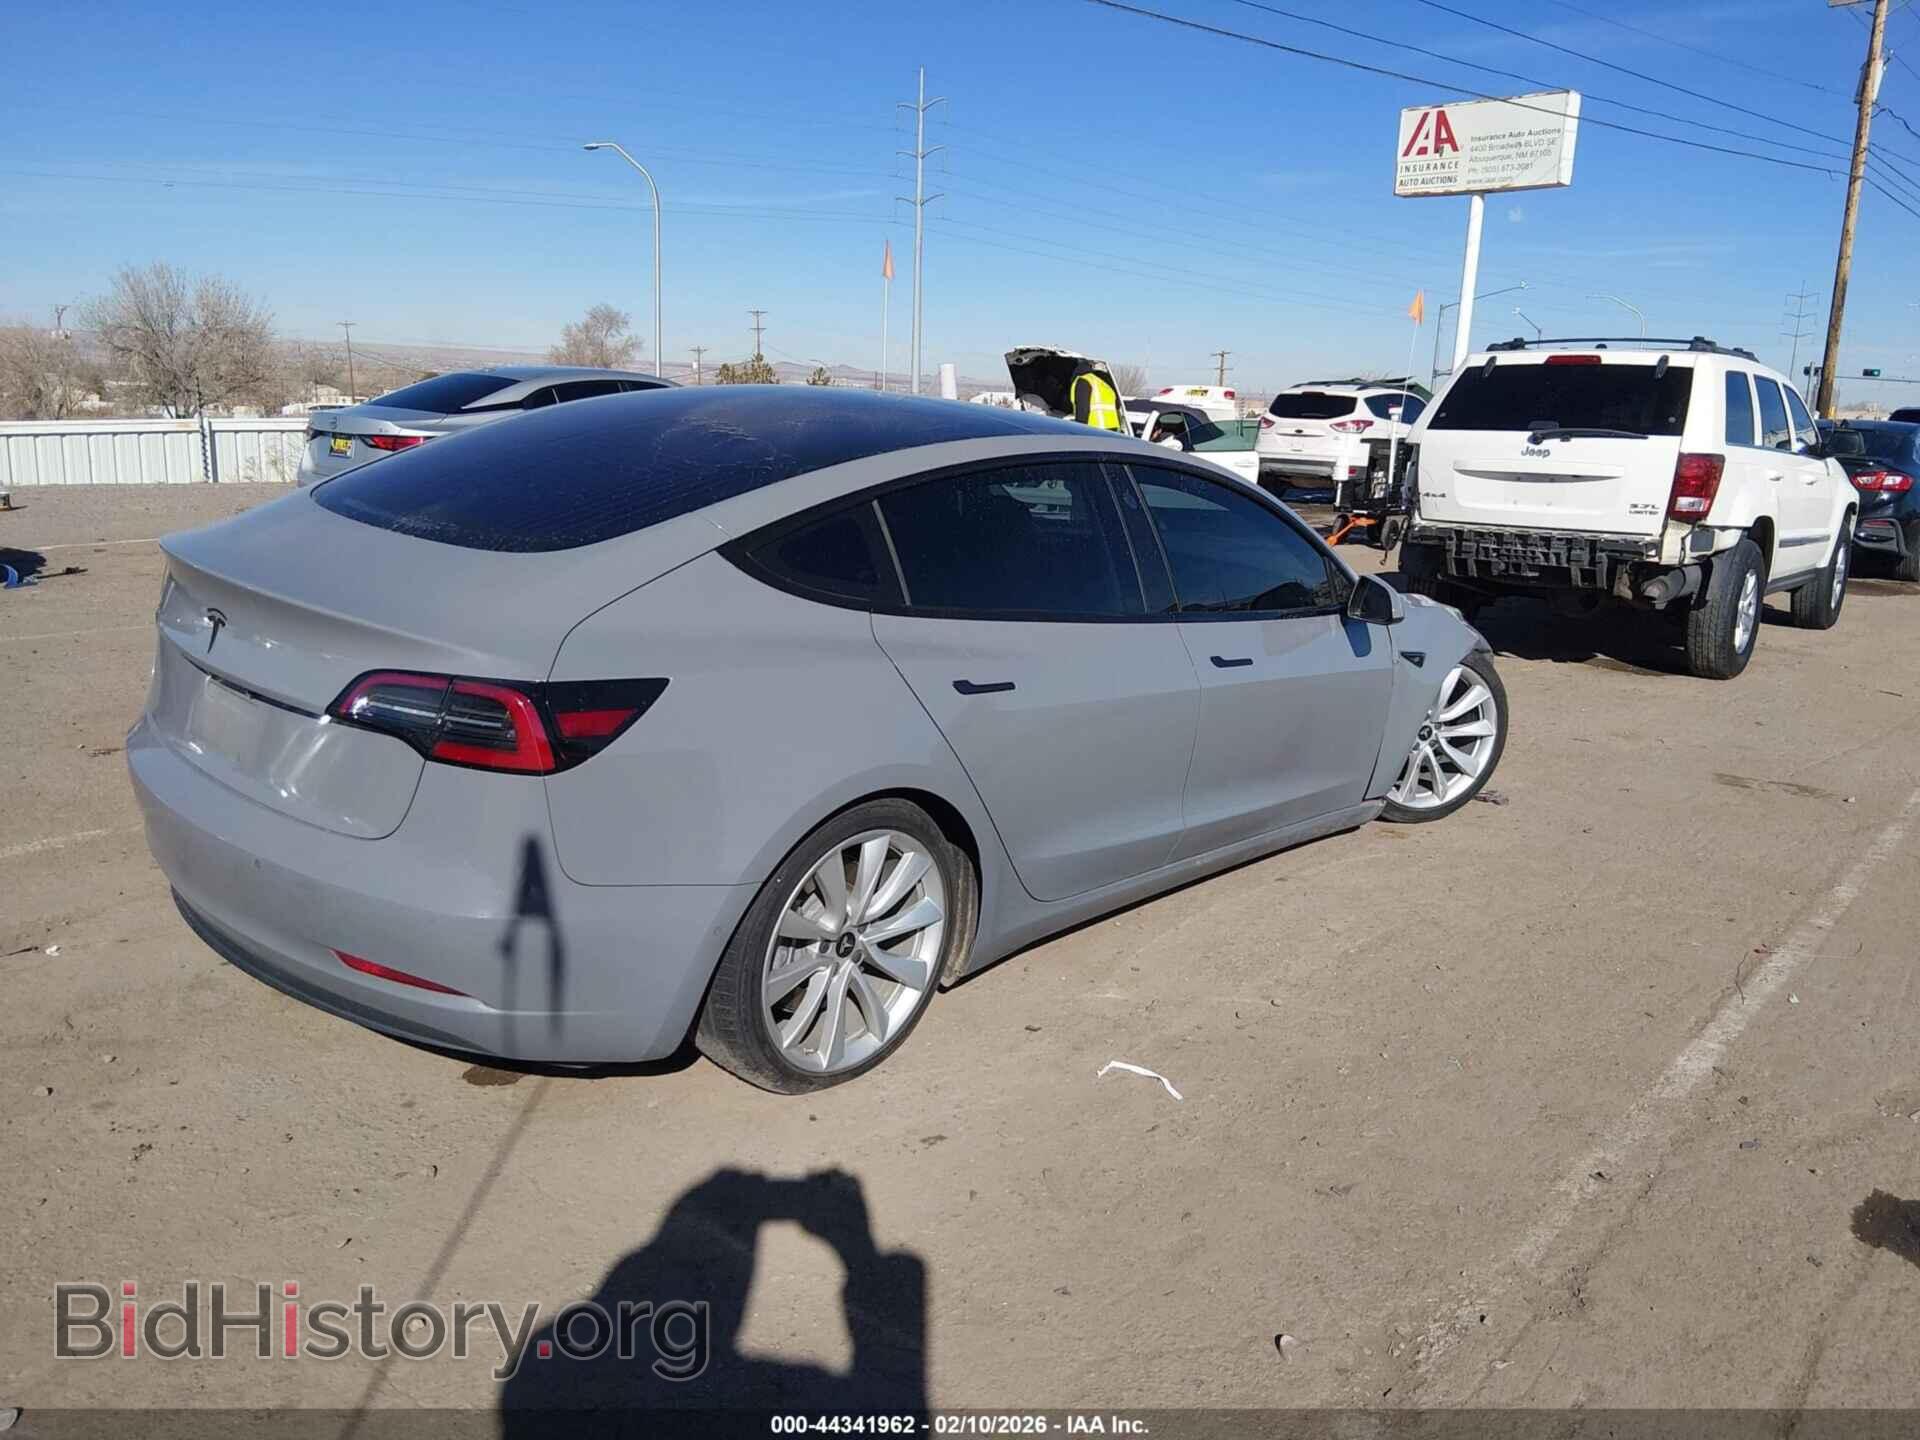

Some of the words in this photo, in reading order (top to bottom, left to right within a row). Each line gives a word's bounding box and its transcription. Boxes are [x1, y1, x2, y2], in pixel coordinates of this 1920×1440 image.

[1470, 133, 1506, 143] Insurance
[1508, 130, 1526, 139] Auto
[1527, 127, 1562, 137] Auctions
[1400, 161, 1459, 173] INSURANCE
[1398, 177, 1420, 187] AUTO
[1420, 175, 1458, 186] AUCTIONS
[1520, 446, 1551, 459] Jeep
